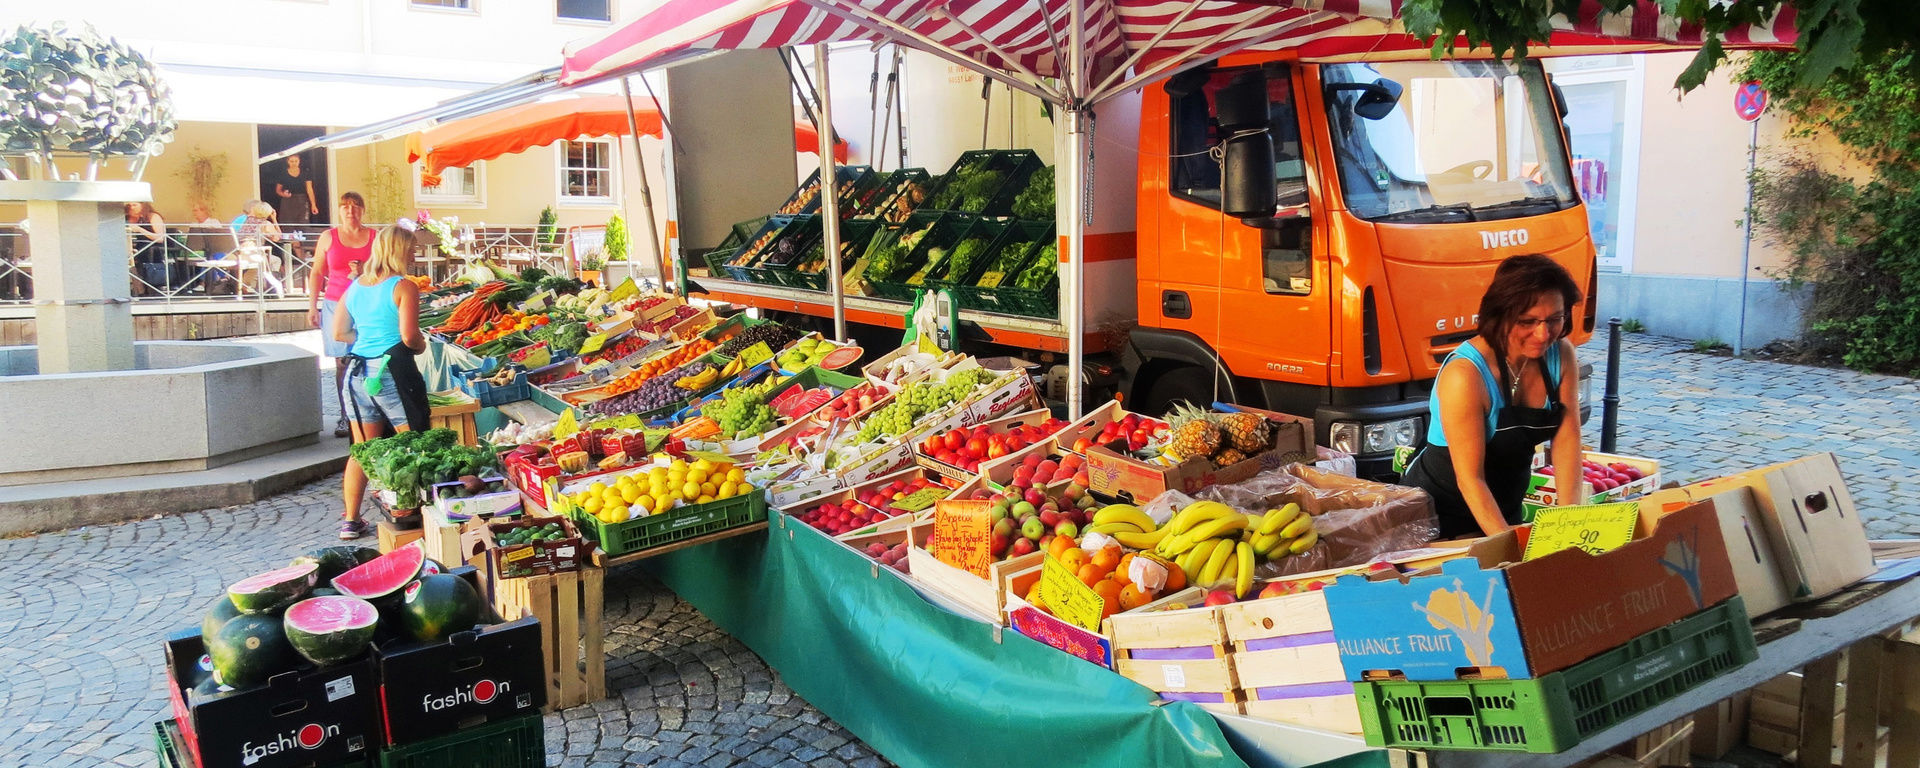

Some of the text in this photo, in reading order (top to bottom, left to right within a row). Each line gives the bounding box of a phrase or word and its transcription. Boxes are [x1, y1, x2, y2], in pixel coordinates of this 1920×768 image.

[1478, 228, 1529, 250] IVECO
[988, 387, 1033, 415] Reginella
[1535, 580, 1669, 655] ALLIANCE FRUIT
[1339, 633, 1452, 656] ALLIANCE FRUIT
